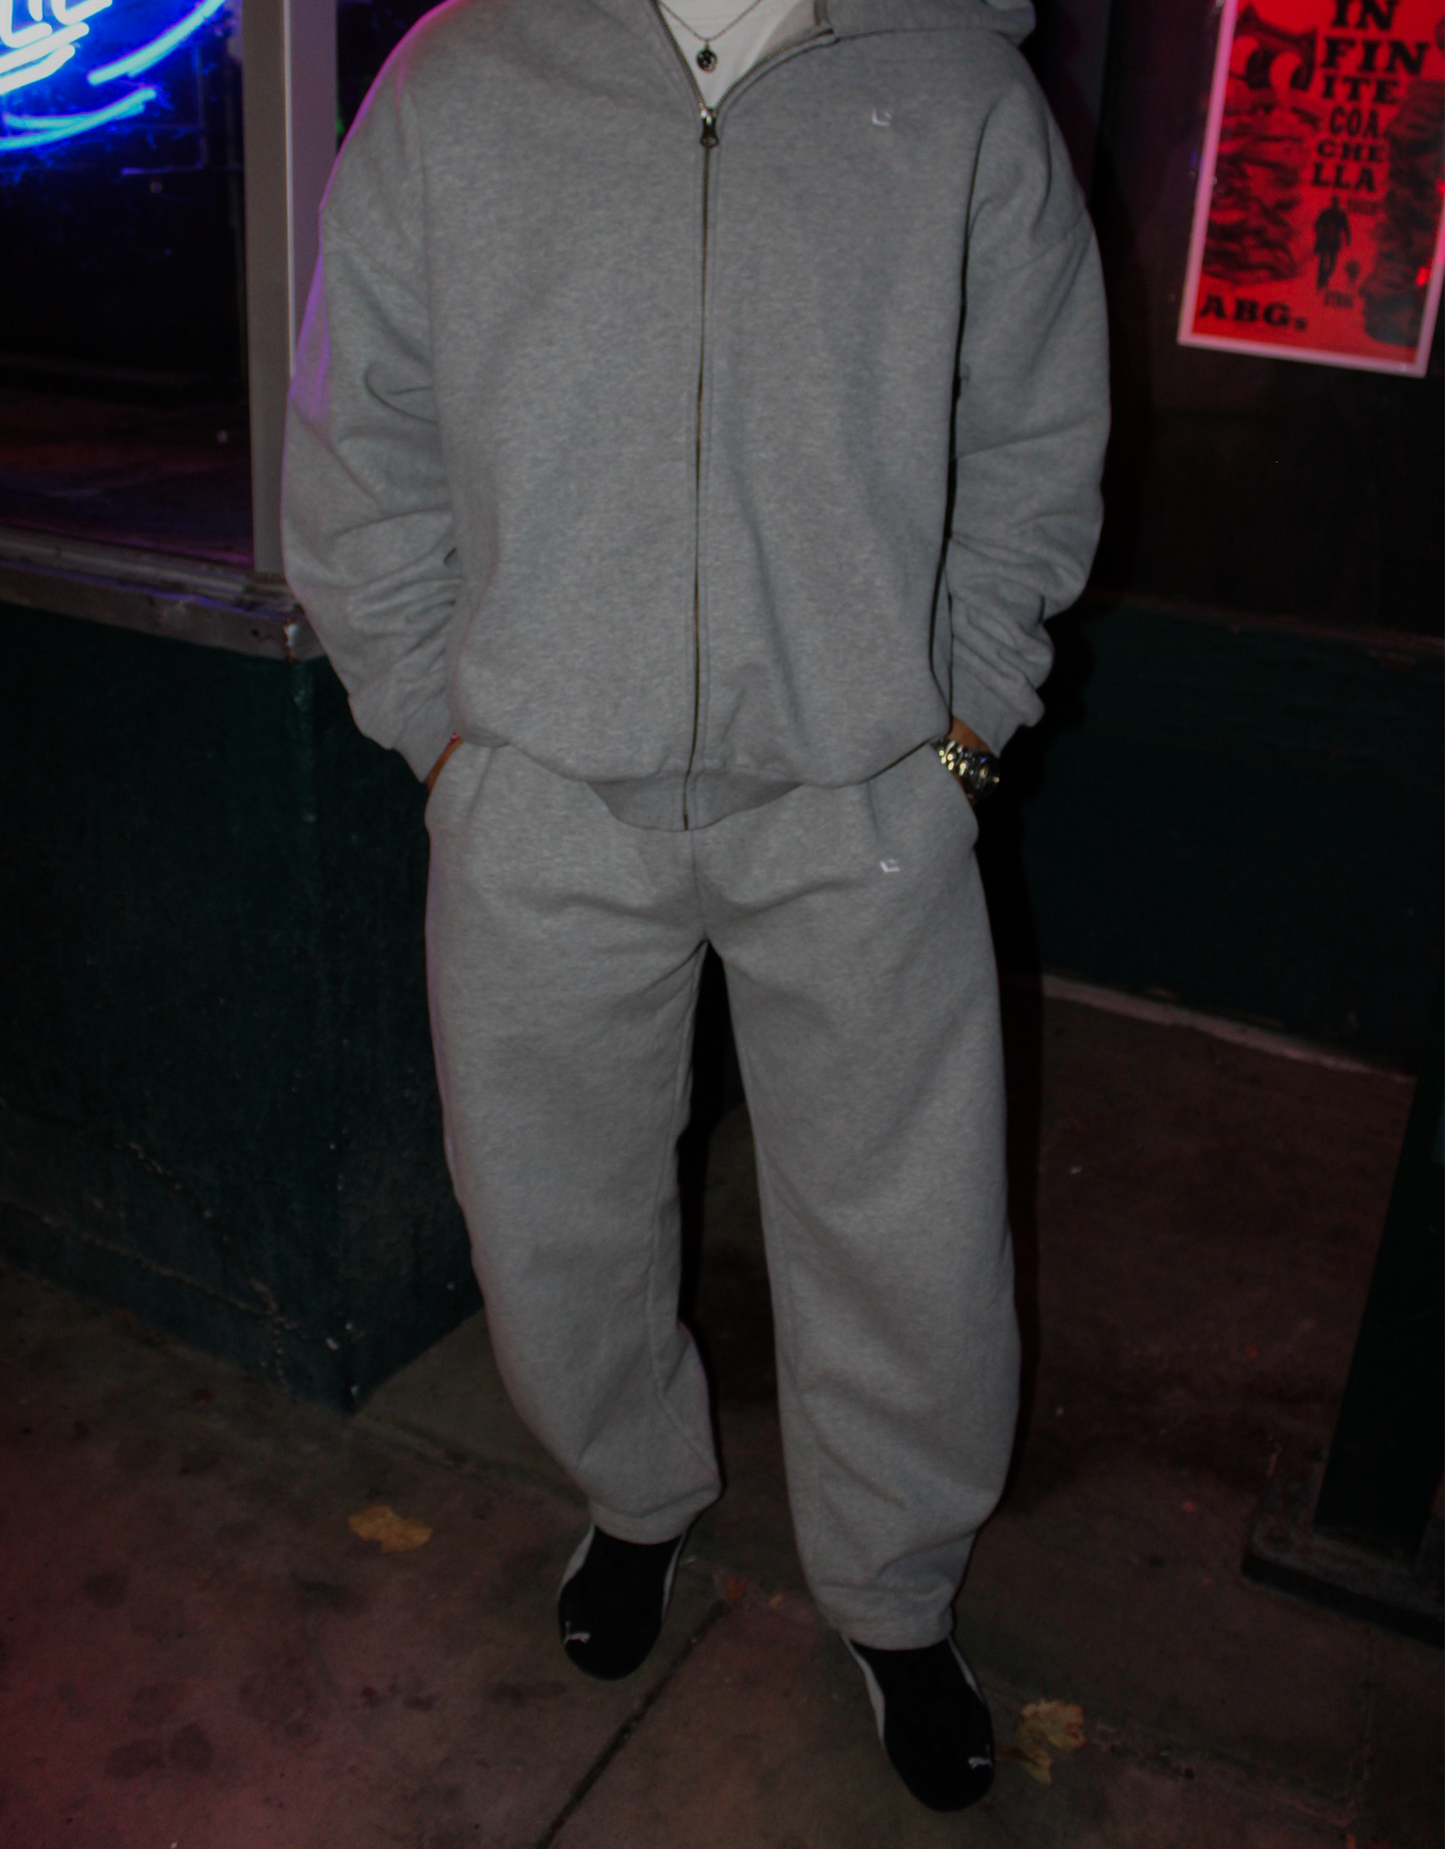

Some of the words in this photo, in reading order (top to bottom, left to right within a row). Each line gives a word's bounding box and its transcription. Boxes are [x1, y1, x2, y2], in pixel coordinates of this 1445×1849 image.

[1331, 0, 1399, 31] IN
[1321, 37, 1430, 76] FIN
[1321, 75, 1399, 105] ITE
[1330, 107, 1381, 139] COA
[1317, 140, 1386, 162] CHE
[1312, 162, 1377, 192] LLA
